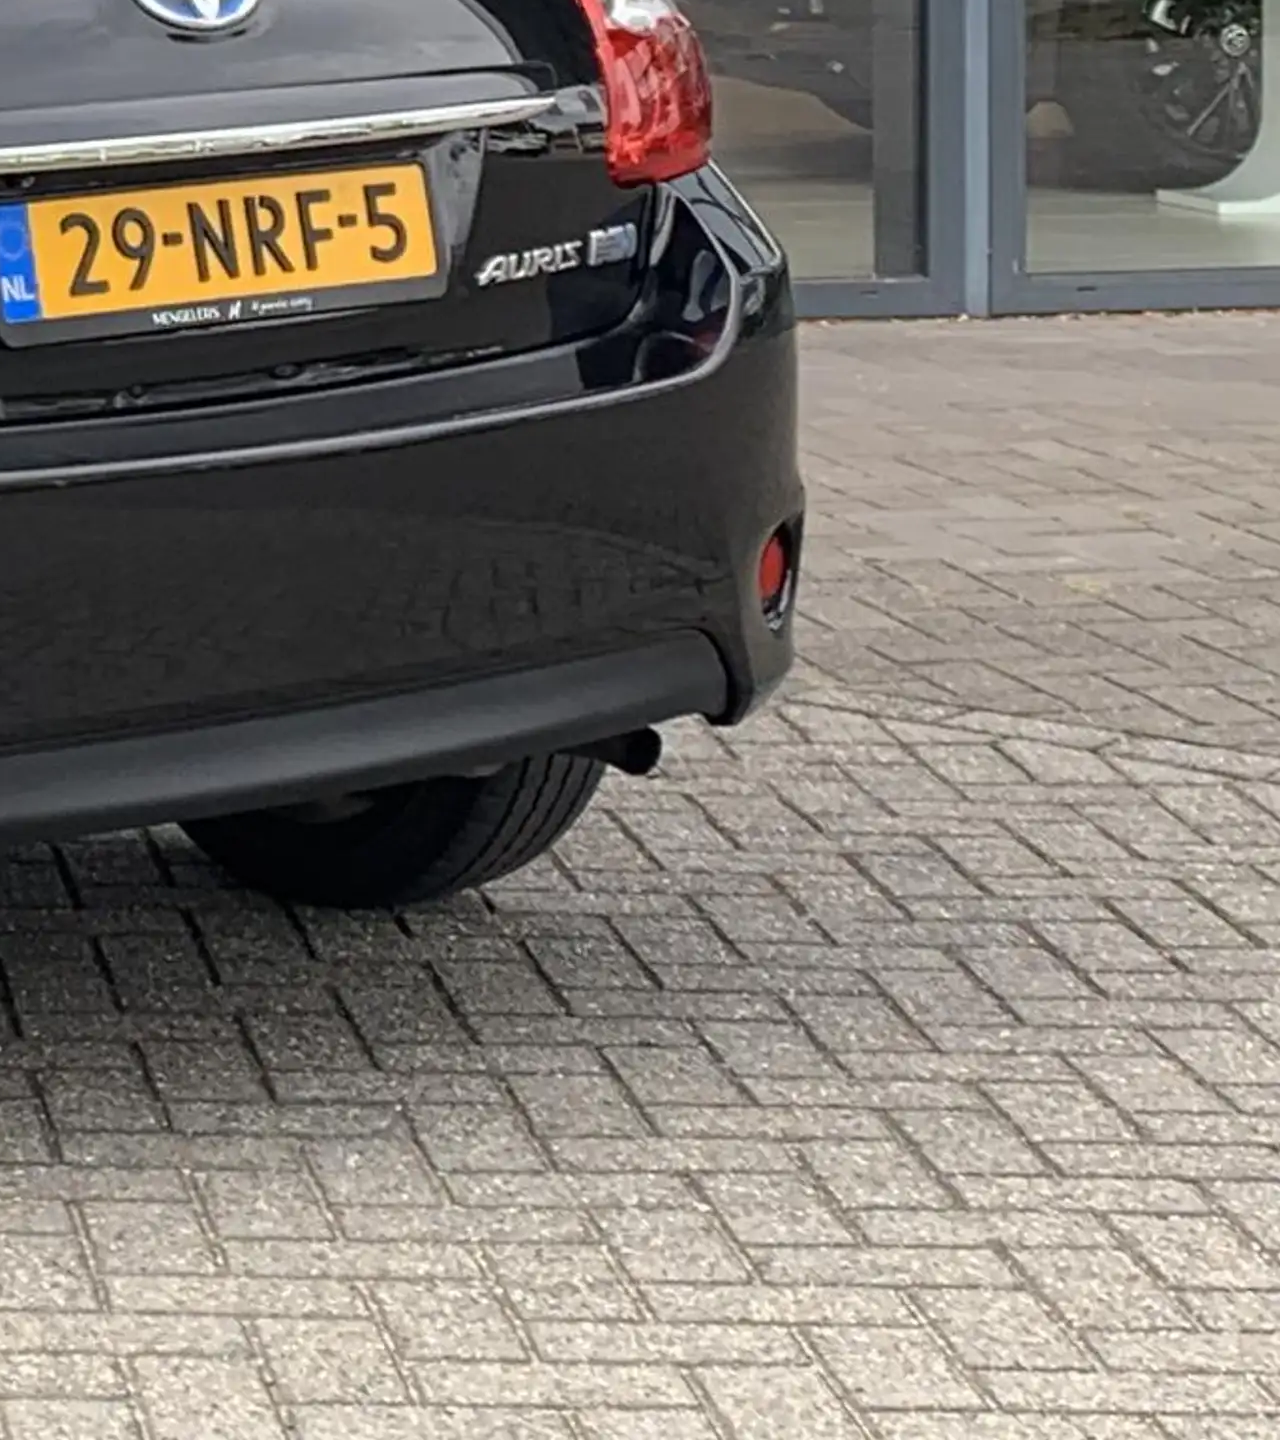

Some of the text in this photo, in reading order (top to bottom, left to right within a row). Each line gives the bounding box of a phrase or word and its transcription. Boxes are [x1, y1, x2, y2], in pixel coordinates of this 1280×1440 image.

[59, 181, 408, 298] 29-NRF-5
[474, 240, 584, 286] AURIS
[1, 274, 35, 303] NL
